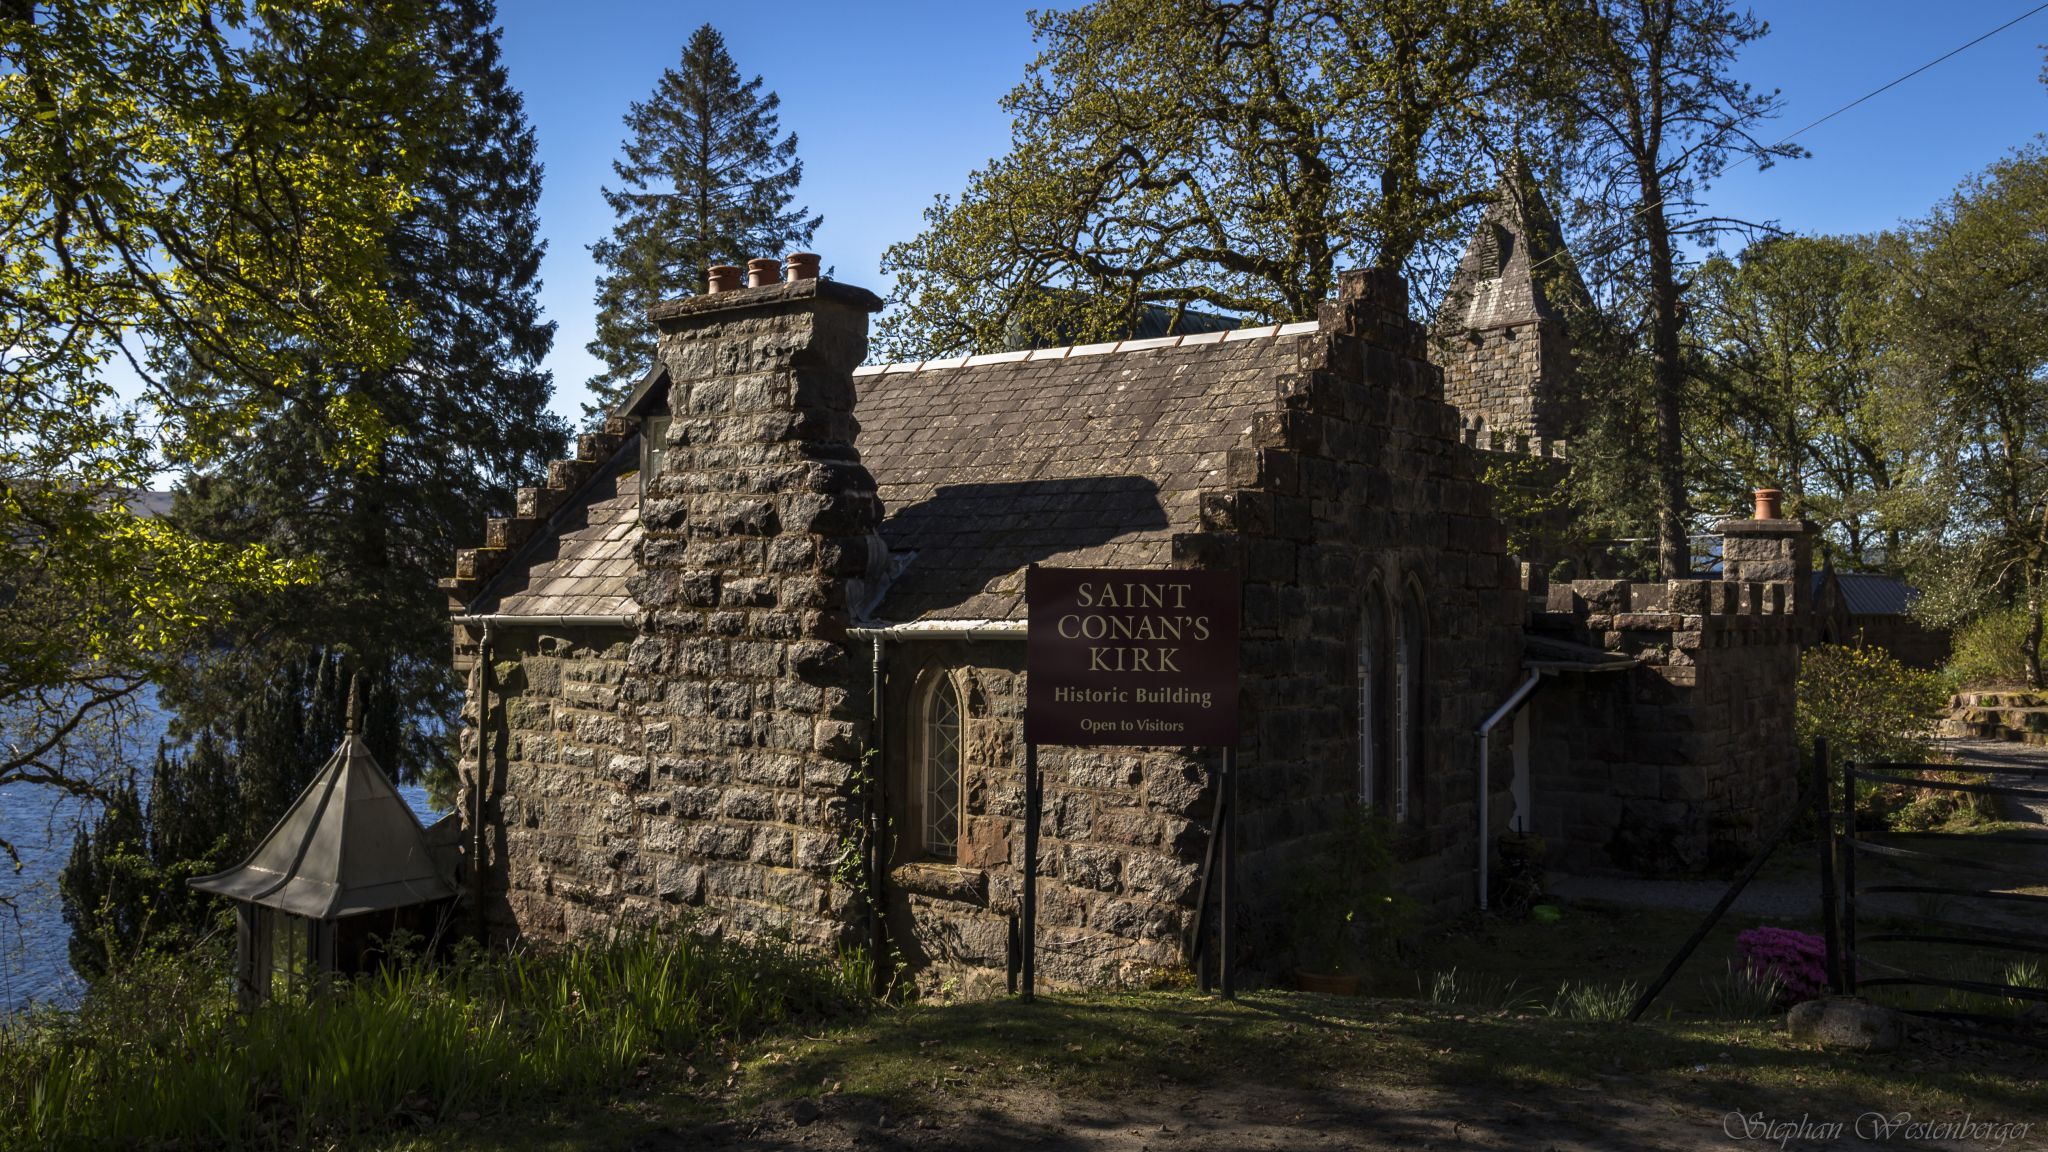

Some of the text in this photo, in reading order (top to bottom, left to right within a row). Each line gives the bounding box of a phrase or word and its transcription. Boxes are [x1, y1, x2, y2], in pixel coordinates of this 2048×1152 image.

[1077, 582, 1191, 608] SAINT
[1057, 614, 1210, 641] CONAN'S
[1088, 647, 1181, 672] KIRK
[1055, 686, 1212, 708] Historic Building
[1080, 718, 1184, 734] Open to Visitors
